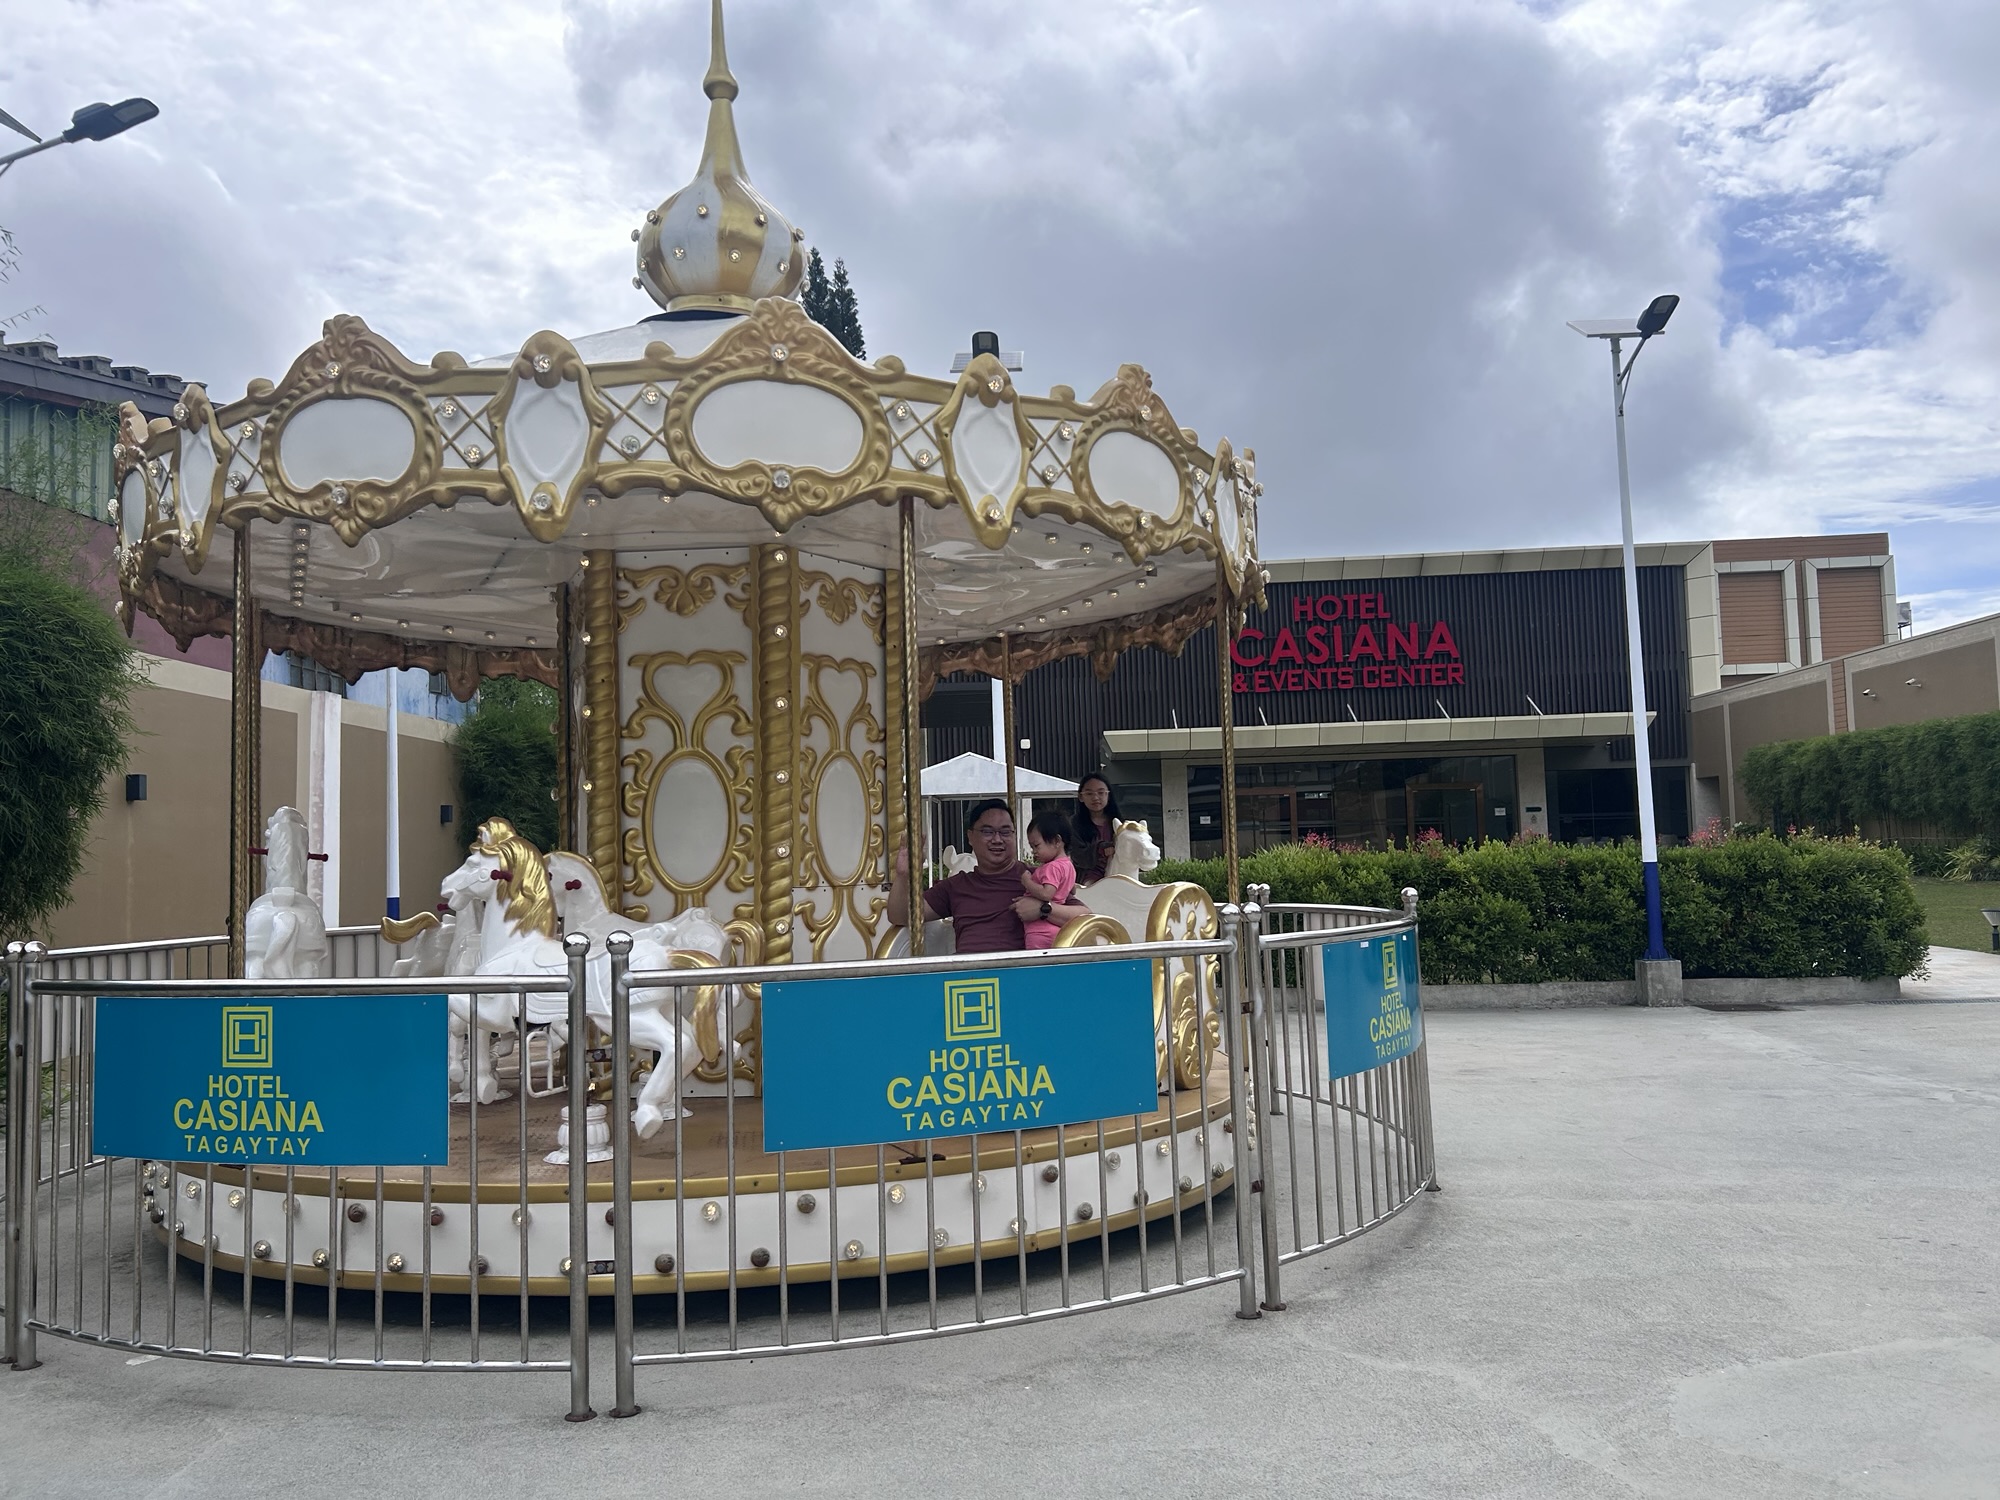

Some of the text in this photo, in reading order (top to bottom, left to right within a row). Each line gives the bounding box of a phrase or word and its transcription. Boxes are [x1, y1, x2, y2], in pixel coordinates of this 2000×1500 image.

[1293, 592, 1391, 622] HOTEL
[1230, 620, 1460, 667] CASIANA
[1231, 662, 1465, 693] & EVENTS CENTER
[1381, 992, 1403, 1014] HOTEL
[1370, 1006, 1412, 1043] CASIANA
[929, 1044, 1020, 1073] HOTEL
[1375, 1033, 1411, 1060] TAGAYTAY
[208, 1074, 289, 1098] HOTEL
[886, 1064, 1056, 1109] CASIANA
[173, 1098, 324, 1133] CASIANA
[901, 1100, 1044, 1131] TAGAYTAY
[184, 1135, 311, 1156] TAGAYTAY
